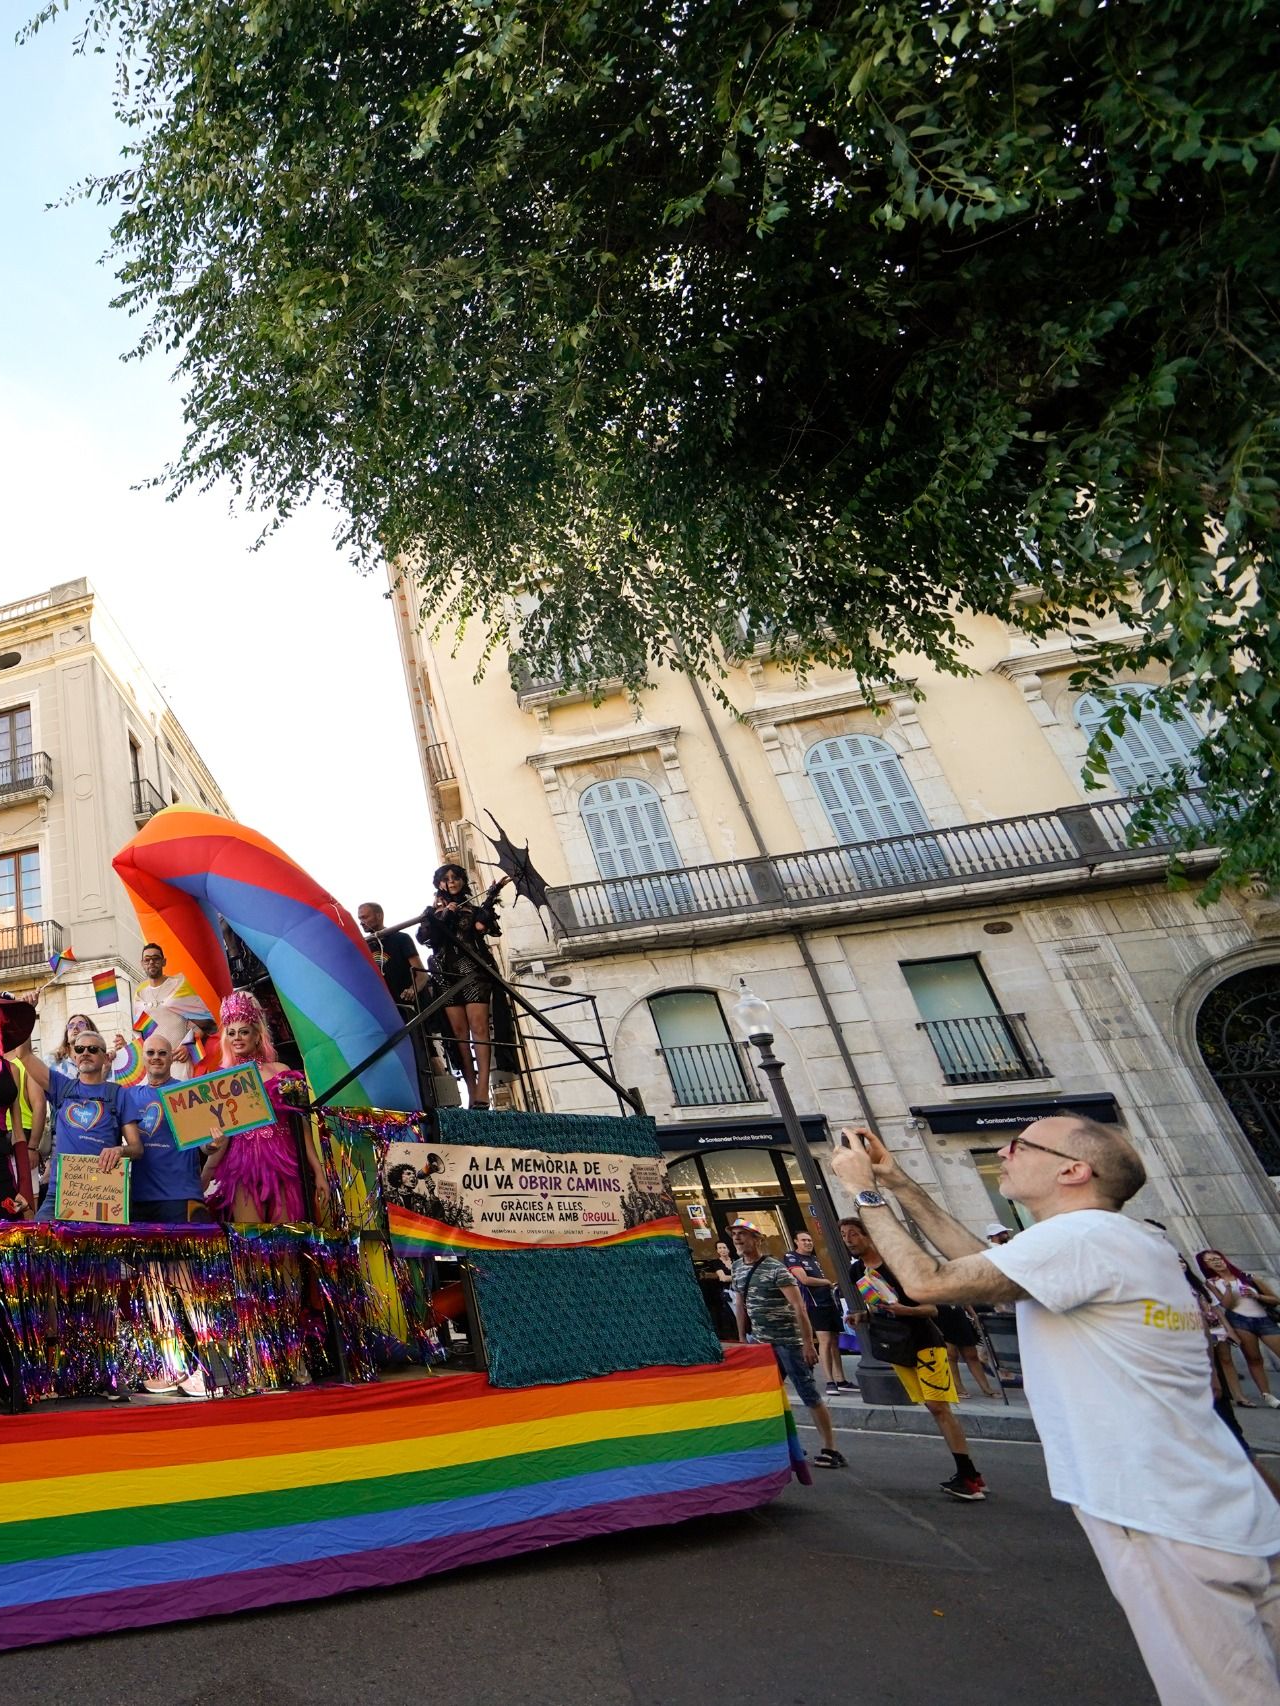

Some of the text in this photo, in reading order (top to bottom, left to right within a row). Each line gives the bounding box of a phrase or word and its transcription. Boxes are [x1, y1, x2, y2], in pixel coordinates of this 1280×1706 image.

[168, 1071, 257, 1113] MARICÓN
[209, 1098, 239, 1128] Y?
[469, 1155, 601, 1175] A LA MEMÒRIA DE
[462, 1173, 489, 1191] QUI
[494, 1174, 514, 1190] VA
[518, 1175, 562, 1191] OBRIR
[567, 1176, 625, 1193] CAMINS.
[500, 1198, 544, 1211] GRÀCIES
[547, 1201, 554, 1211] A
[480, 1212, 505, 1223] AVUI
[509, 1212, 555, 1223] AVANCEM
[558, 1212, 579, 1222] AMB
